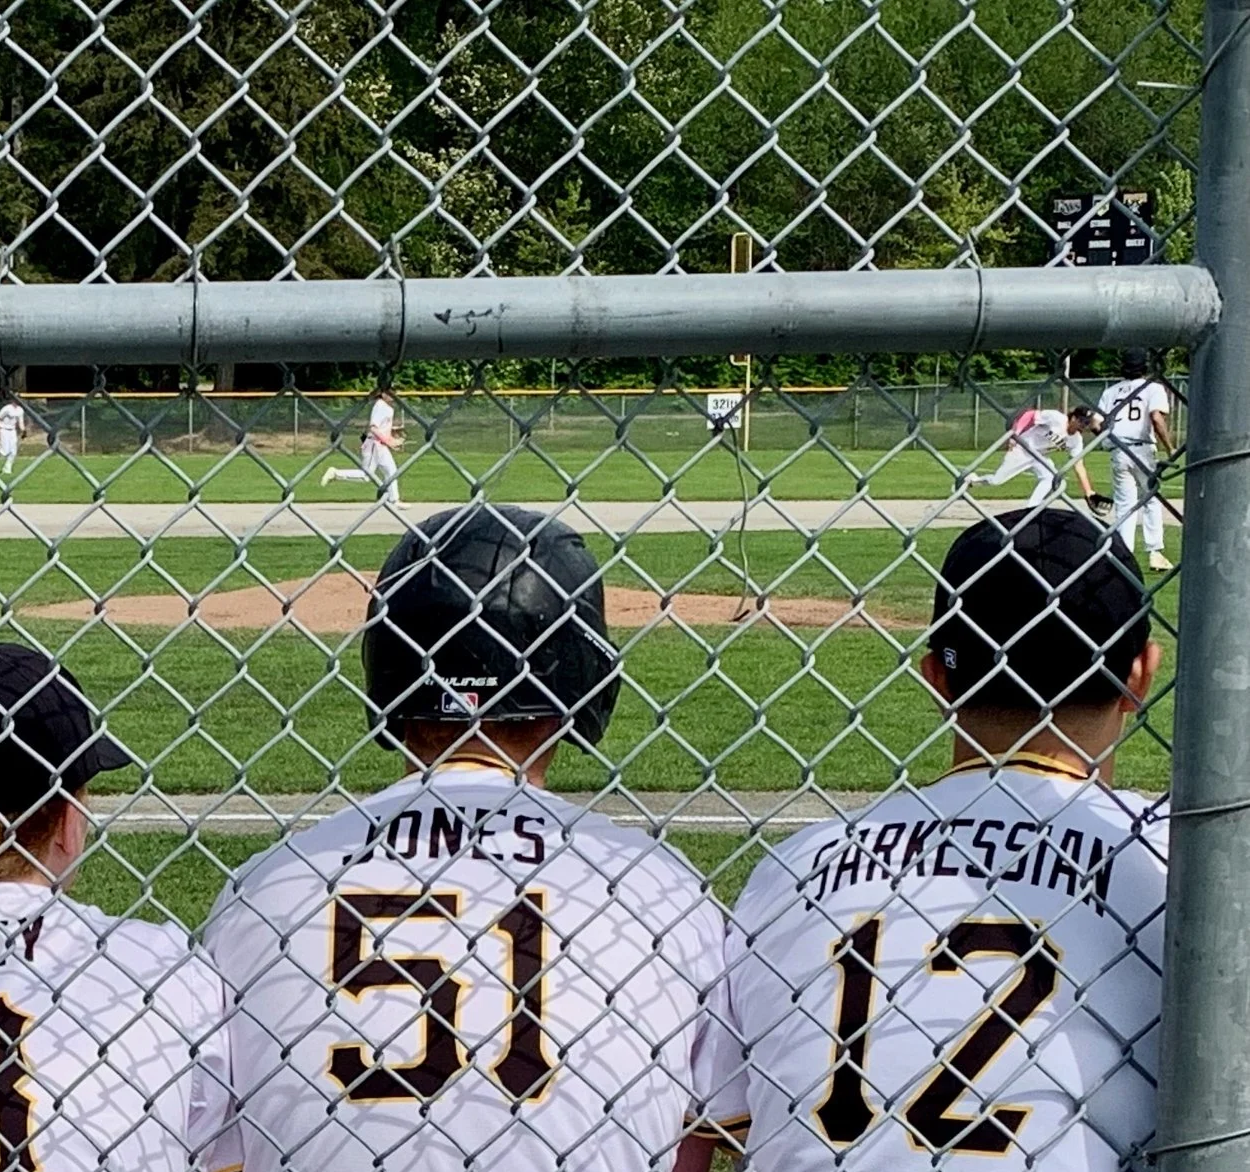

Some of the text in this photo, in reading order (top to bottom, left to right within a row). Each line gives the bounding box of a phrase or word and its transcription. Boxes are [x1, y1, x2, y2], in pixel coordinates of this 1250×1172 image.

[342, 806, 545, 866] JONES
[805, 817, 1115, 918] SARKESSIAN
[326, 888, 558, 1103] 51
[811, 912, 1064, 1157] 12
